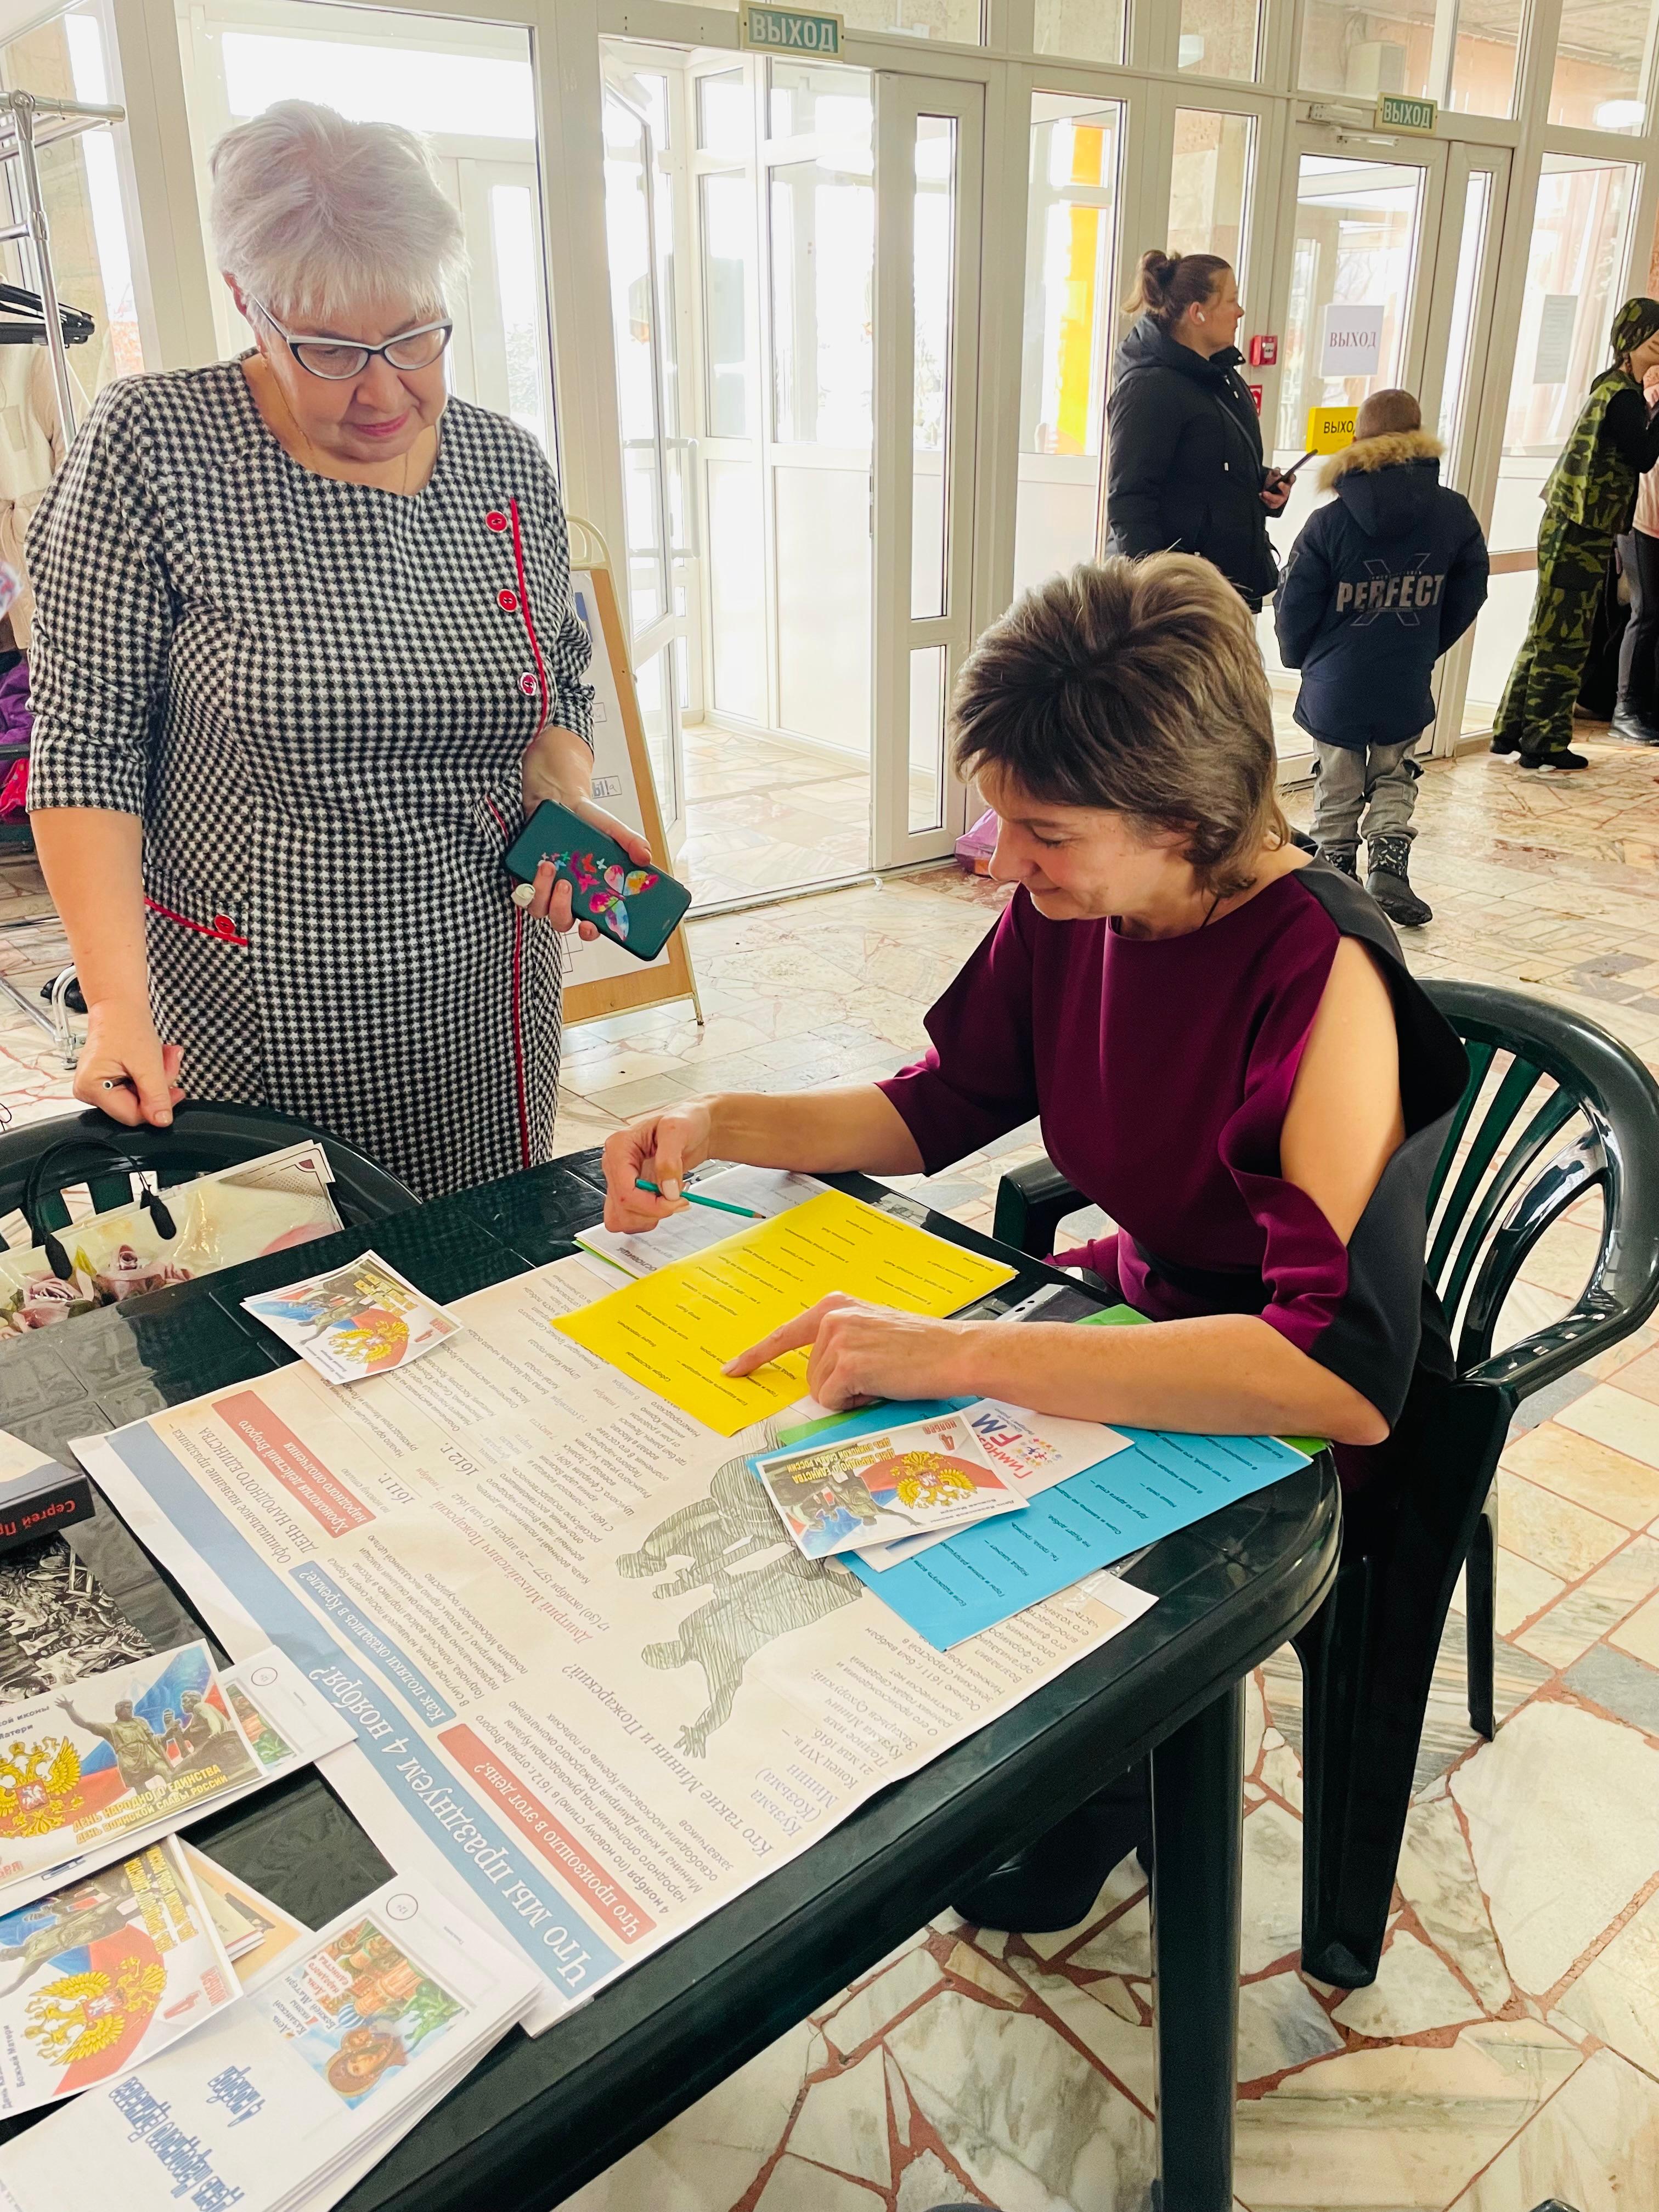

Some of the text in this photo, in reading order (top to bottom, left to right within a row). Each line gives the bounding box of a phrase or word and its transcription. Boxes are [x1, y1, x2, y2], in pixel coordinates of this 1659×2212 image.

[749, 10, 837, 53] ВЫХОД
[1383, 100, 1432, 128] ВЫХОД
[1329, 331, 1376, 347] ВЫХОД
[1323, 420, 1355, 433] ВЫХО
[1335, 574, 1445, 612] PERFECT
[521, 1372, 549, 1395] Битва под
[625, 1351, 671, 1382] Собери пословицы
[376, 1418, 419, 1452] руководством
[595, 1426, 620, 1446] составе
[650, 1401, 701, 1437] Нижегородского
[919, 1419, 960, 1436] НОЯБРЯ
[970, 1413, 1023, 1447] FM
[382, 1438, 404, 1458] Начало
[584, 1432, 642, 1478] Первого народного
[783, 1436, 894, 1474] ДЕНЬ ВОИНСКОЙ СЛАВЫ РОССИИ
[935, 1431, 962, 1452] 4
[238, 1420, 349, 1533] Хронология действий Второго
[280, 1440, 367, 1523] народного ополчения
[447, 1452, 479, 1476] 1612
[556, 1455, 600, 1488] февраля 1609
[587, 1465, 619, 1486] воевода
[788, 1446, 899, 1485] ДЕНЬ НАРОДНОГО ЕДИНСТВА
[171, 1428, 291, 1564] Официальное название праздника
[198, 1426, 319, 1554] ДЕНЬ НАРОДНОГО ЕДИНСТВА
[385, 1482, 415, 1504] 1611
[617, 1472, 652, 1499] Рязанского
[21, 1499, 76, 1529] Сергей
[486, 1478, 585, 1561] военный Второго народного
[431, 1500, 593, 1644] Дмитрий Михайлович Пожарский
[490, 1525, 583, 1610] октября 1577 апреля
[539, 1541, 571, 1568] военный
[358, 1547, 452, 1639] под помощи
[326, 1557, 465, 1700] смутное Бориса
[351, 1562, 455, 1664] польские войска Россию
[298, 1570, 446, 1722] Как поляки оказались Кремле?
[458, 1606, 528, 1674] покорить Московское
[907, 1643, 954, 1674] старостой
[849, 1655, 892, 1686] сведений
[864, 1627, 980, 1711] Осенью 1611 был выбран
[966, 1666, 1005, 1695] Нижнем
[974, 1649, 1023, 1684] Возглавил
[16, 1705, 49, 1720] иконы
[307, 1665, 415, 1758] 4 ноября?
[905, 1679, 963, 1722] практически
[561, 1663, 774, 1858] Кто такие Минин Пожарский?
[71, 1761, 223, 1835] ДЕНЬ НАРОДНОГО ЕДИНСТВА
[508, 1700, 703, 1893] Минина князя Дмитрия Пожарского окончательно
[546, 1712, 718, 1881] освободили московский Кремль польских
[754, 1767, 822, 1822] (Козьма)
[786, 1763, 839, 1809] Минин
[74, 1772, 230, 1844] ДЕНЬ ВОИНСКОЙ СЛАВЫ РОССИИ
[475, 1714, 664, 1906] ноября новому 1612 отряды Второго
[503, 1719, 687, 1903] народного ополчения под руководством Кузьмы
[749, 1788, 803, 1837] Кузьма
[473, 1762, 640, 1938] Что произошло этот день?
[678, 1819, 733, 1871] захватчиков
[395, 1756, 600, 1987] Что мы празднуем
[121, 1854, 174, 1957] ДЕНЬ НАРОДНОГО ЕДИНСТВА
[141, 1844, 199, 1944] ДЕНЬ ВОИНСКОЙ СЛАВЫ РОССИИ
[197, 1964, 229, 2007] НОЯБРЯ
[304, 1976, 324, 1996] День
[308, 1960, 340, 1993] народного
[318, 1953, 349, 1988] единства
[160, 1993, 205, 2022] 4
[284, 1976, 312, 2005] Матери
[269, 2015, 291, 2034] День
[272, 1999, 307, 2035] Казанской
[289, 1999, 311, 2022] иконы
[6, 2024, 18, 2057] Матери
[207, 2066, 251, 2104] ноября
[108, 2076, 174, 2141] Единства
[146, 2123, 213, 2198] Народного
